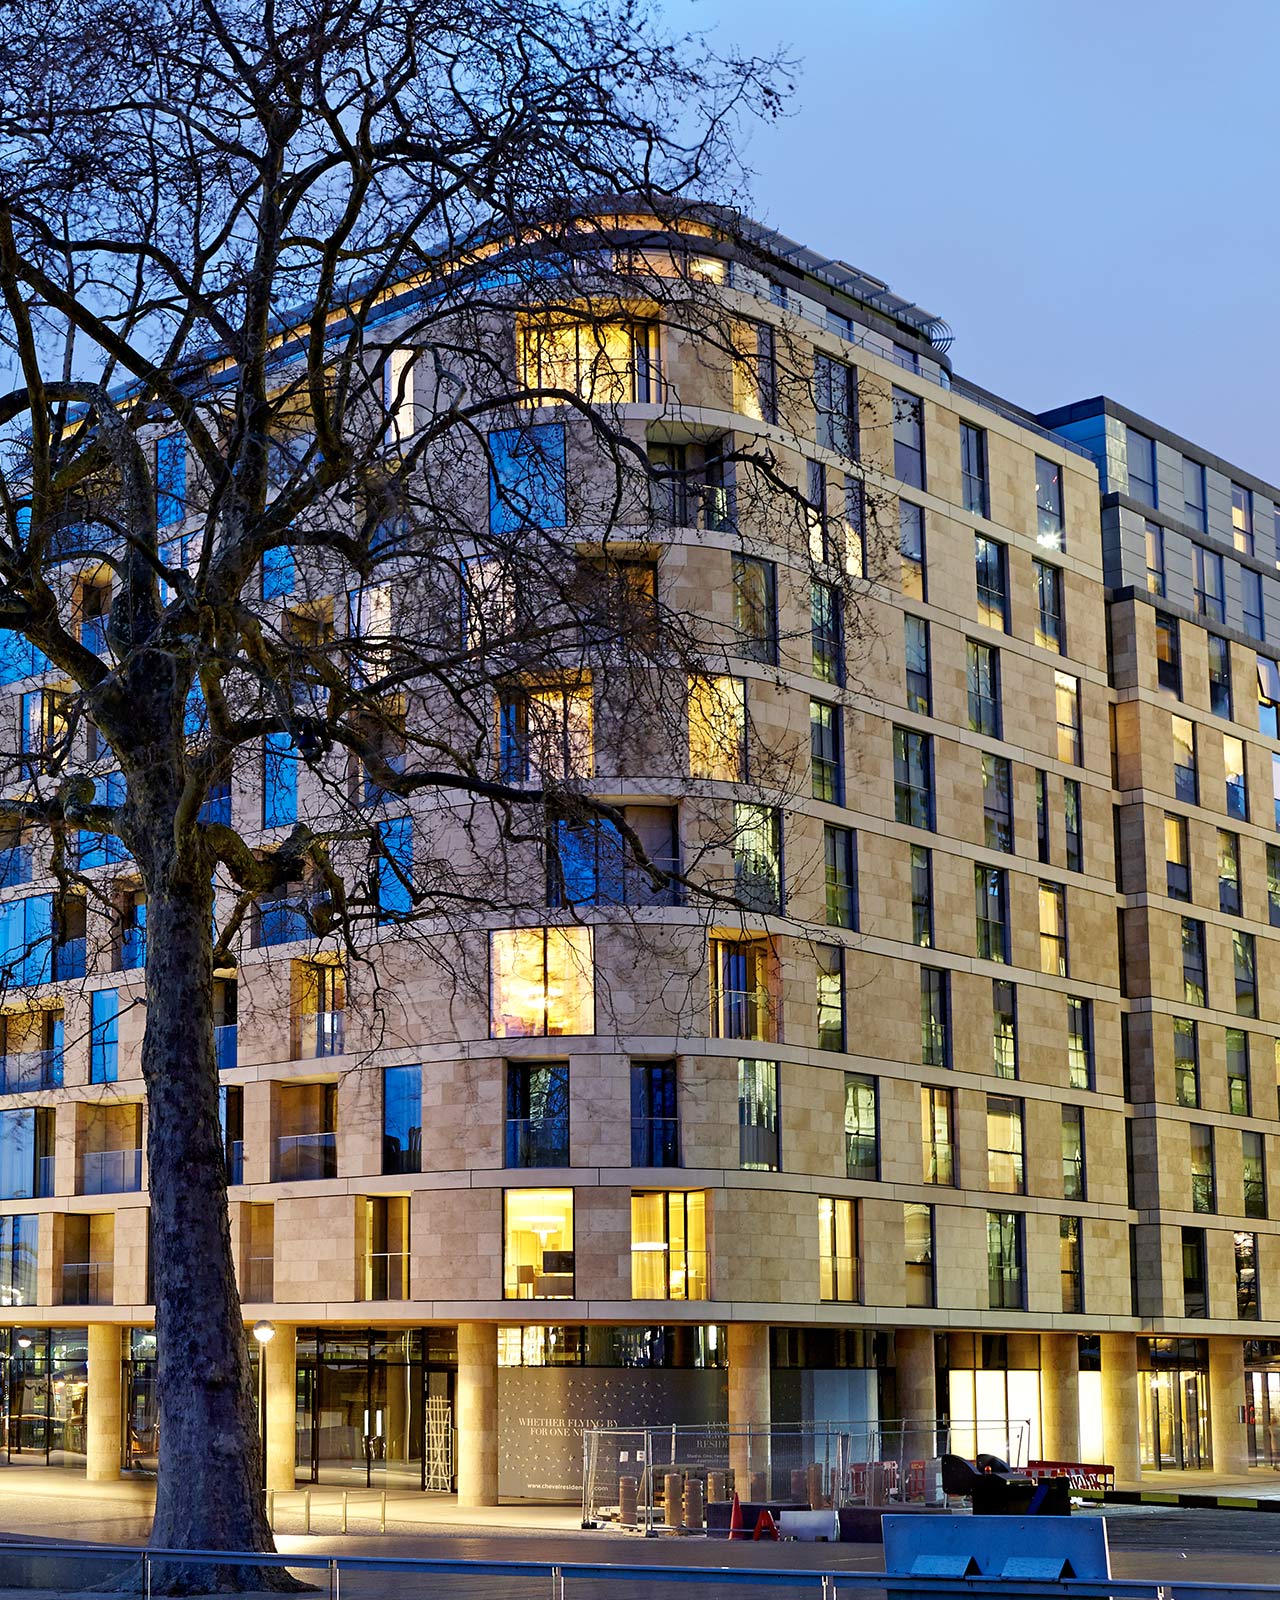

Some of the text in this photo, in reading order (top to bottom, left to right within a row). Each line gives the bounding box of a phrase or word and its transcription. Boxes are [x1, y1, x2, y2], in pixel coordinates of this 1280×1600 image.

[518, 1417, 618, 1428] WHETHER FLYING BY
[530, 1428, 548, 1437] FOR
[549, 1428, 570, 1437] ONE
